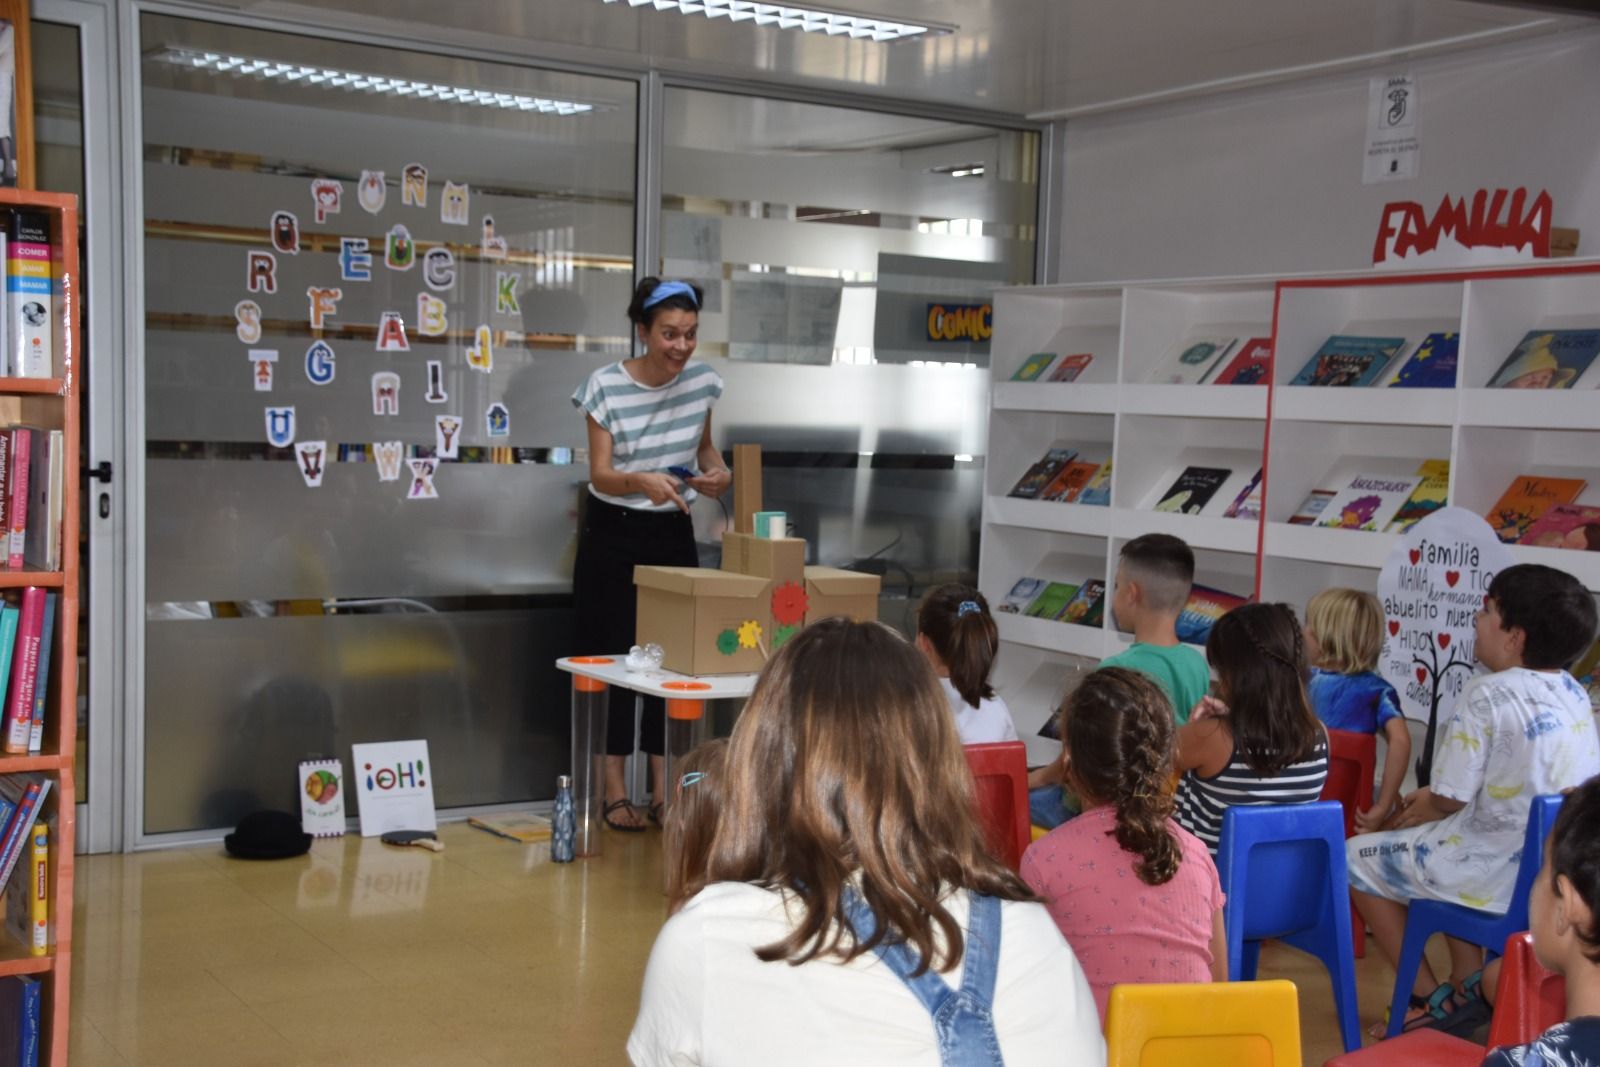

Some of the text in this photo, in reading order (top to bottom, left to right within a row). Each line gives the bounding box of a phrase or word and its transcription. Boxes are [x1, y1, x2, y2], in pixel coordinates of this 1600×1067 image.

[313, 181, 341, 222] P
[274, 213, 298, 252] Q
[1373, 187, 1553, 265] FAMILIA
[18, 247, 48, 257] COMER
[341, 239, 371, 279] E
[249, 252, 276, 292] R
[308, 288, 341, 328] F
[498, 274, 519, 312] K
[379, 315, 408, 349] A
[419, 295, 446, 333] B
[306, 341, 334, 384] G
[467, 327, 491, 371] J
[267, 408, 294, 446] U
[438, 419, 460, 456] Y
[298, 445, 324, 483] V
[1419, 539, 1479, 567] familia
[1385, 594, 1438, 620] abuelito
[1427, 582, 1482, 605] hermana
[1400, 630, 1428, 651] HIJO
[364, 759, 425, 791] ¡OH!
[1359, 846, 1378, 857] KEEP
